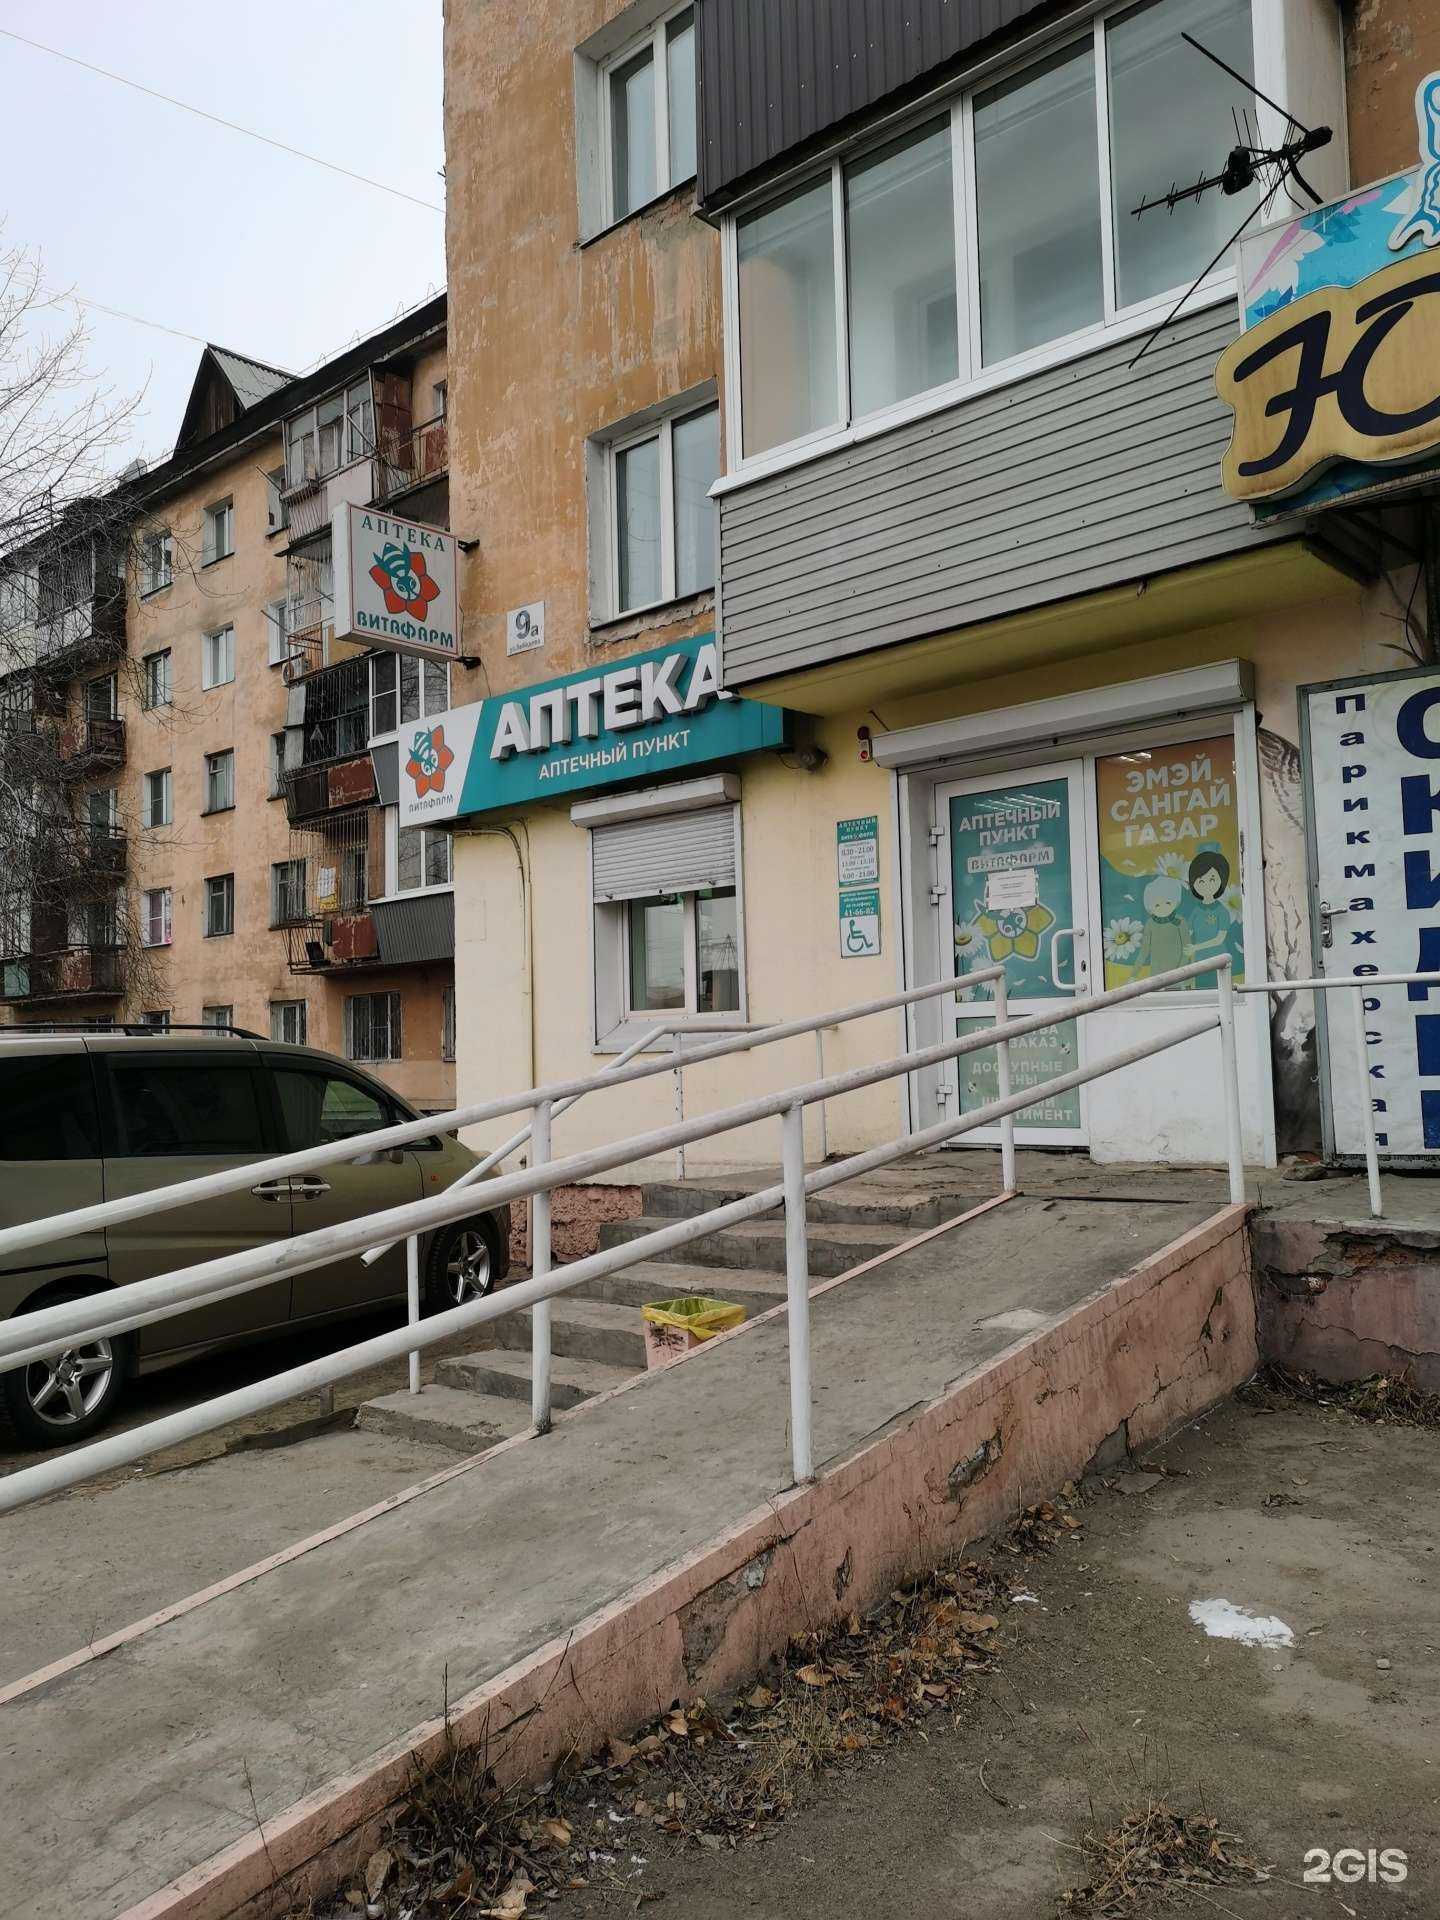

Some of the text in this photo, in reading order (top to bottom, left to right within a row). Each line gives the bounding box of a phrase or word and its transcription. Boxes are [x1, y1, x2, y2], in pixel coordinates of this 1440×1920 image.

[362, 515, 446, 552] АПТЕКА
[357, 611, 454, 648] ВИТАФАРМ
[516, 610, 539, 640] 9а
[490, 643, 732, 761] АПТЕКА
[539, 729, 691, 780] АПТЕЧНЫЙ ПУНКТ
[1125, 752, 1213, 793] ЭМЭЙ
[959, 801, 1061, 832] АПТЕЧНЫЙ
[1110, 778, 1231, 822] САНГАЙ
[980, 824, 1040, 846] ПУНКТ
[1124, 814, 1219, 848] ГАЗАР
[971, 849, 1050, 871] ВИТАФАРМ
[1008, 1036, 1058, 1049] ЗАКАЗ
[972, 1061, 1063, 1075] ДОСУПНЫЕ
